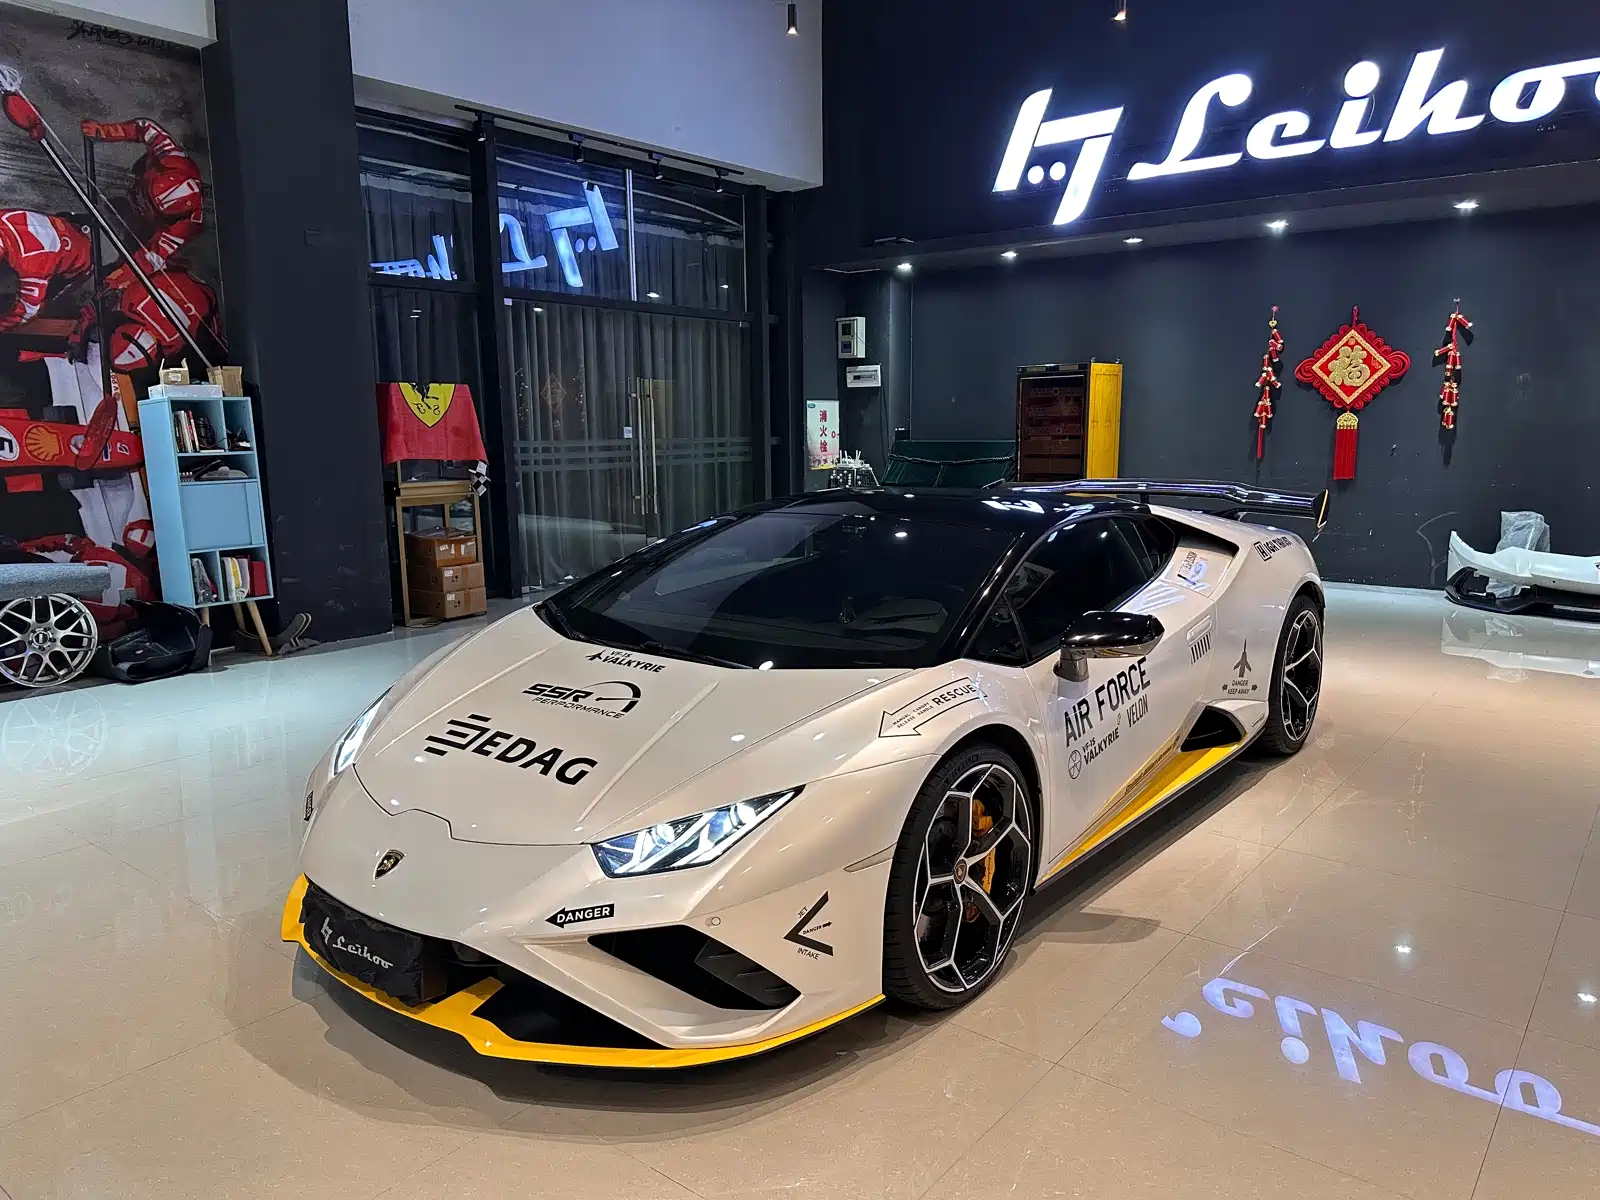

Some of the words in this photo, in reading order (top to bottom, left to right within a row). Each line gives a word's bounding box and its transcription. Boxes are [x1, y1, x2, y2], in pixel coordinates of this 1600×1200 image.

[1127, 46, 1600, 181] Leiho
[1327, 345, 1370, 387] 福
[819, 409, 828, 453] 消火栓
[602, 655, 667, 673] VALKYRIE
[522, 683, 594, 703] SSR
[1231, 679, 1249, 687] DANGER
[932, 684, 977, 706] RESCUE
[1064, 697, 1093, 748] AIR
[1095, 656, 1151, 721] FORCE
[893, 713, 910, 725] MANUAL
[917, 705, 934, 716] HANDLE
[1127, 694, 1149, 728] VELON
[1083, 727, 1120, 765] VALKYRIE
[471, 730, 599, 786] EDAG
[556, 906, 611, 923] DANGER
[798, 906, 809, 919] JET
[803, 925, 822, 935] DANGER
[333, 935, 394, 970] Leihoo
[797, 947, 820, 961] INTAKE
